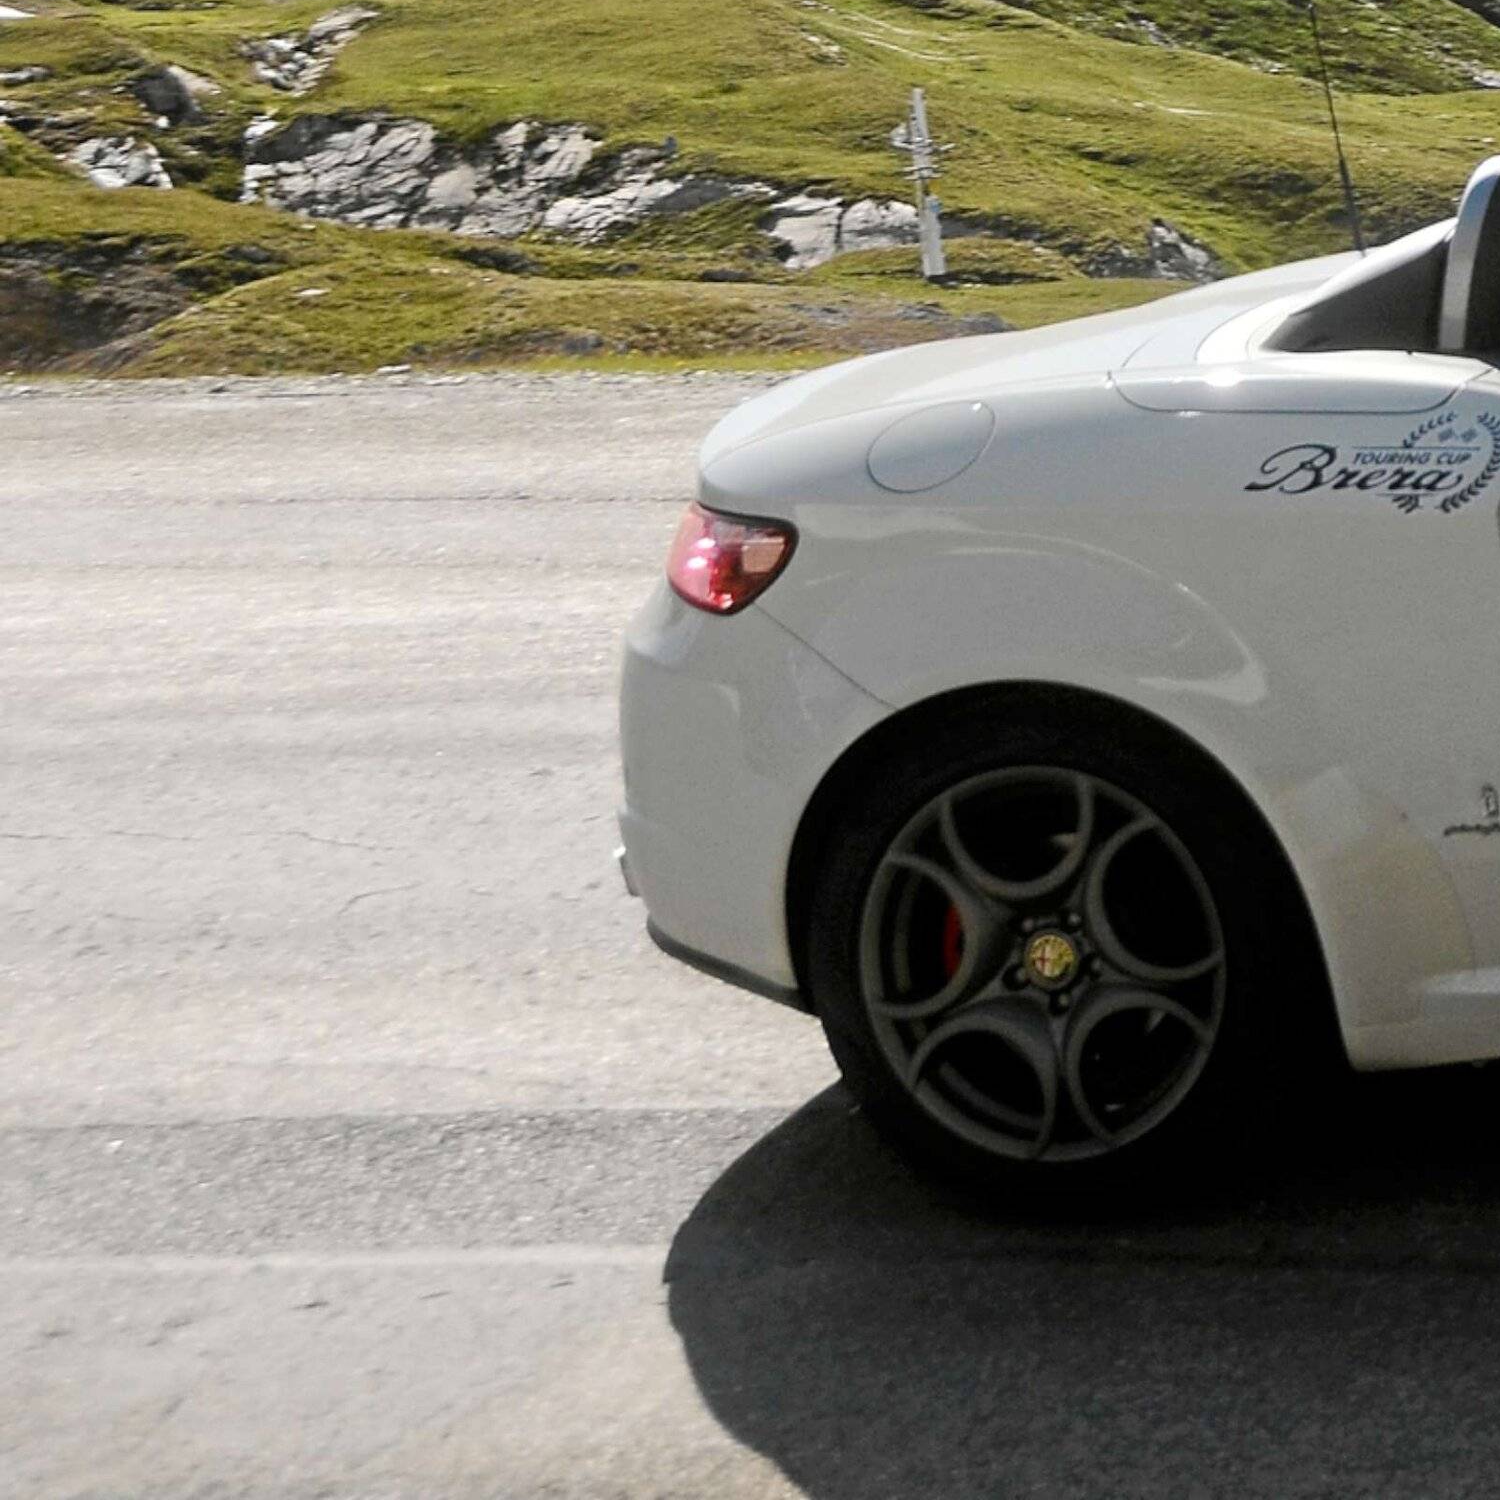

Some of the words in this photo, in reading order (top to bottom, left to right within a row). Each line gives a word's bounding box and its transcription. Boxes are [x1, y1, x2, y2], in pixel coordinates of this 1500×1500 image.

[1243, 443, 1464, 494] Brera
[1353, 451, 1430, 466] TOURING
[1436, 452, 1472, 466] CUP
